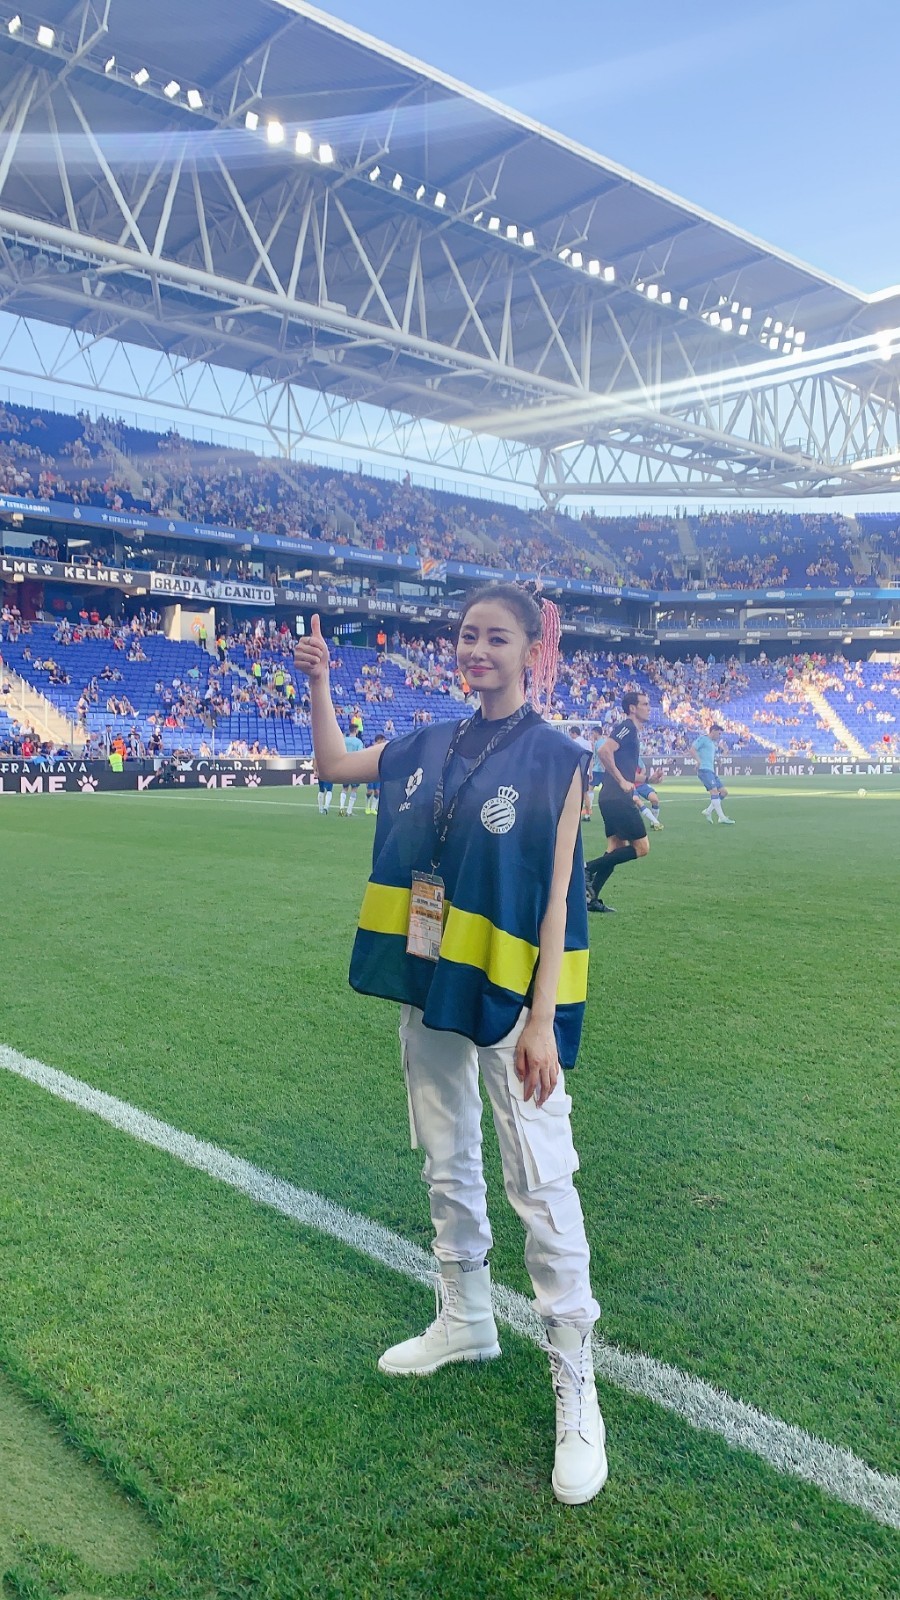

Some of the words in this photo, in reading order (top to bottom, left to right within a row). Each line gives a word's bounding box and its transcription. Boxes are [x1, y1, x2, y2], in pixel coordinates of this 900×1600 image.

[64, 566, 120, 583] KELME
[153, 577, 201, 594] GRADA
[224, 586, 272, 601] CANITO
[765, 764, 805, 776] KELME
[831, 764, 893, 775] KELME
[137, 773, 237, 791] KME
